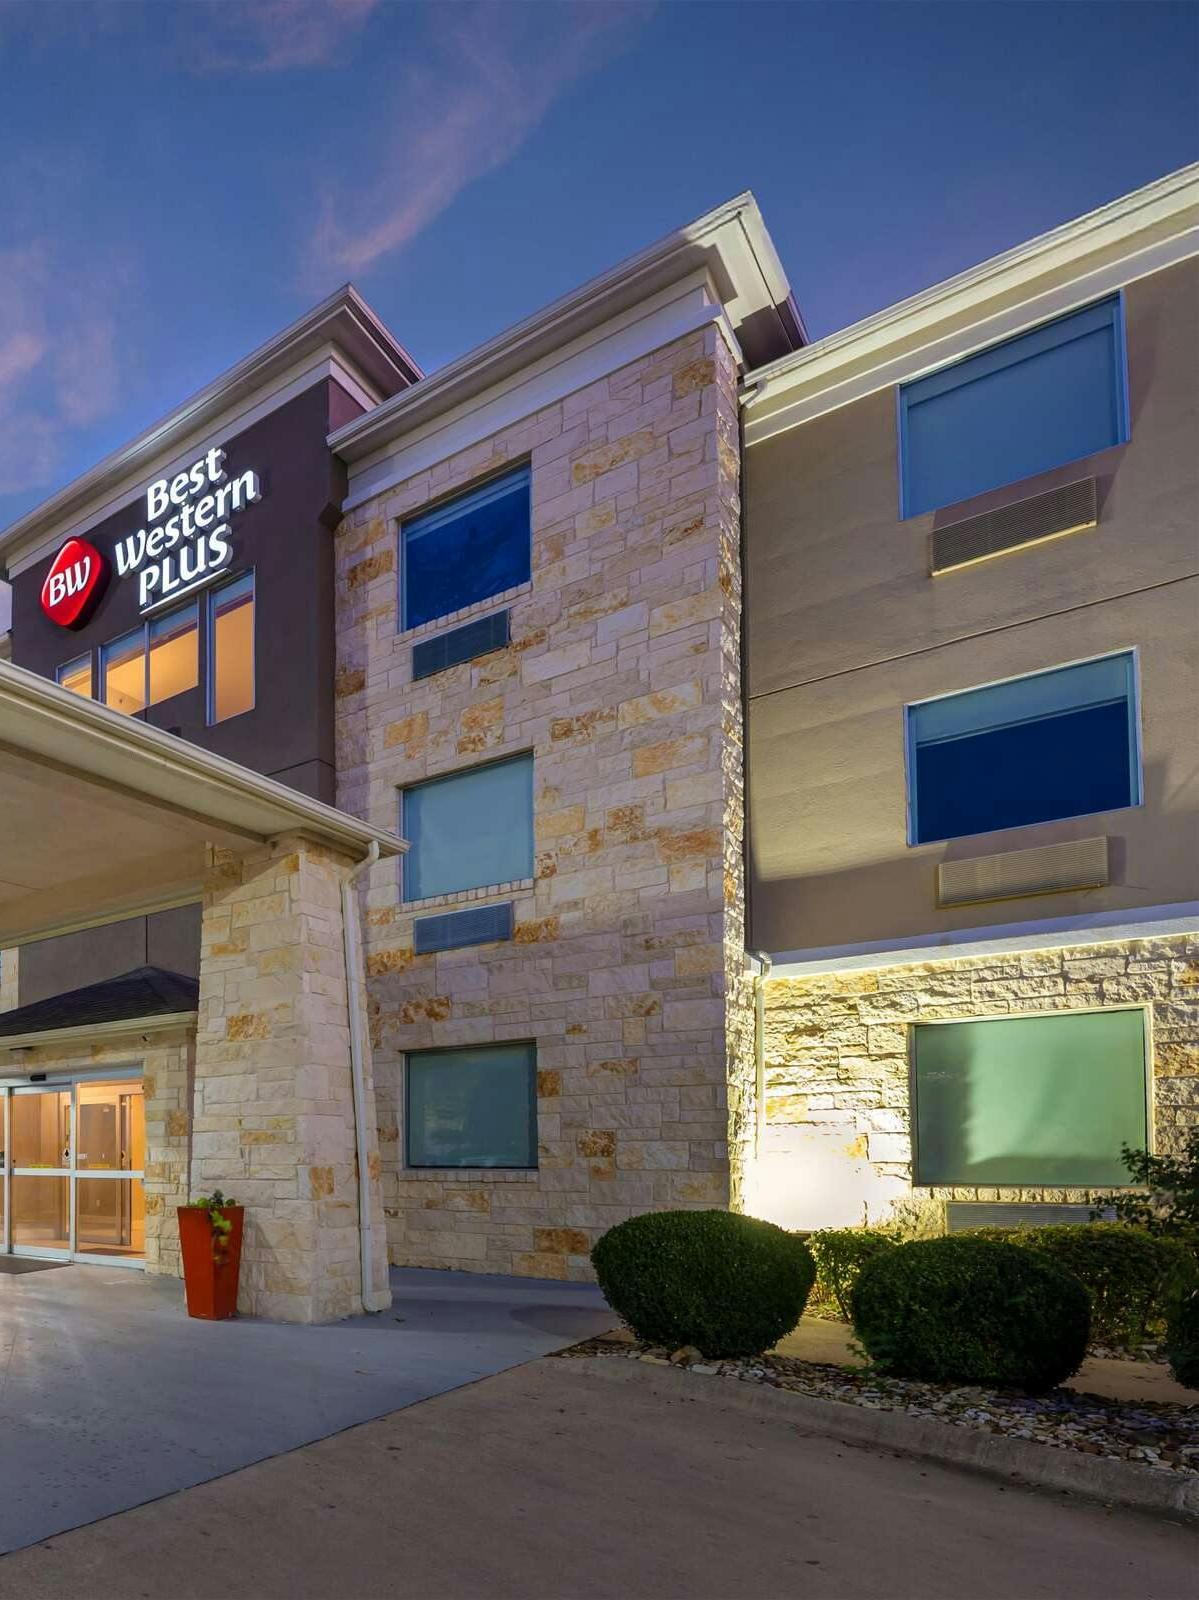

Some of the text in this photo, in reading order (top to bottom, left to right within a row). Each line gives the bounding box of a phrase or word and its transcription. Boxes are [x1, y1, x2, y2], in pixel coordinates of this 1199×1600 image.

[115, 470, 259, 576] Western
[147, 447, 224, 521] Best
[49, 556, 91, 607] BW
[139, 524, 231, 606] PLUS
